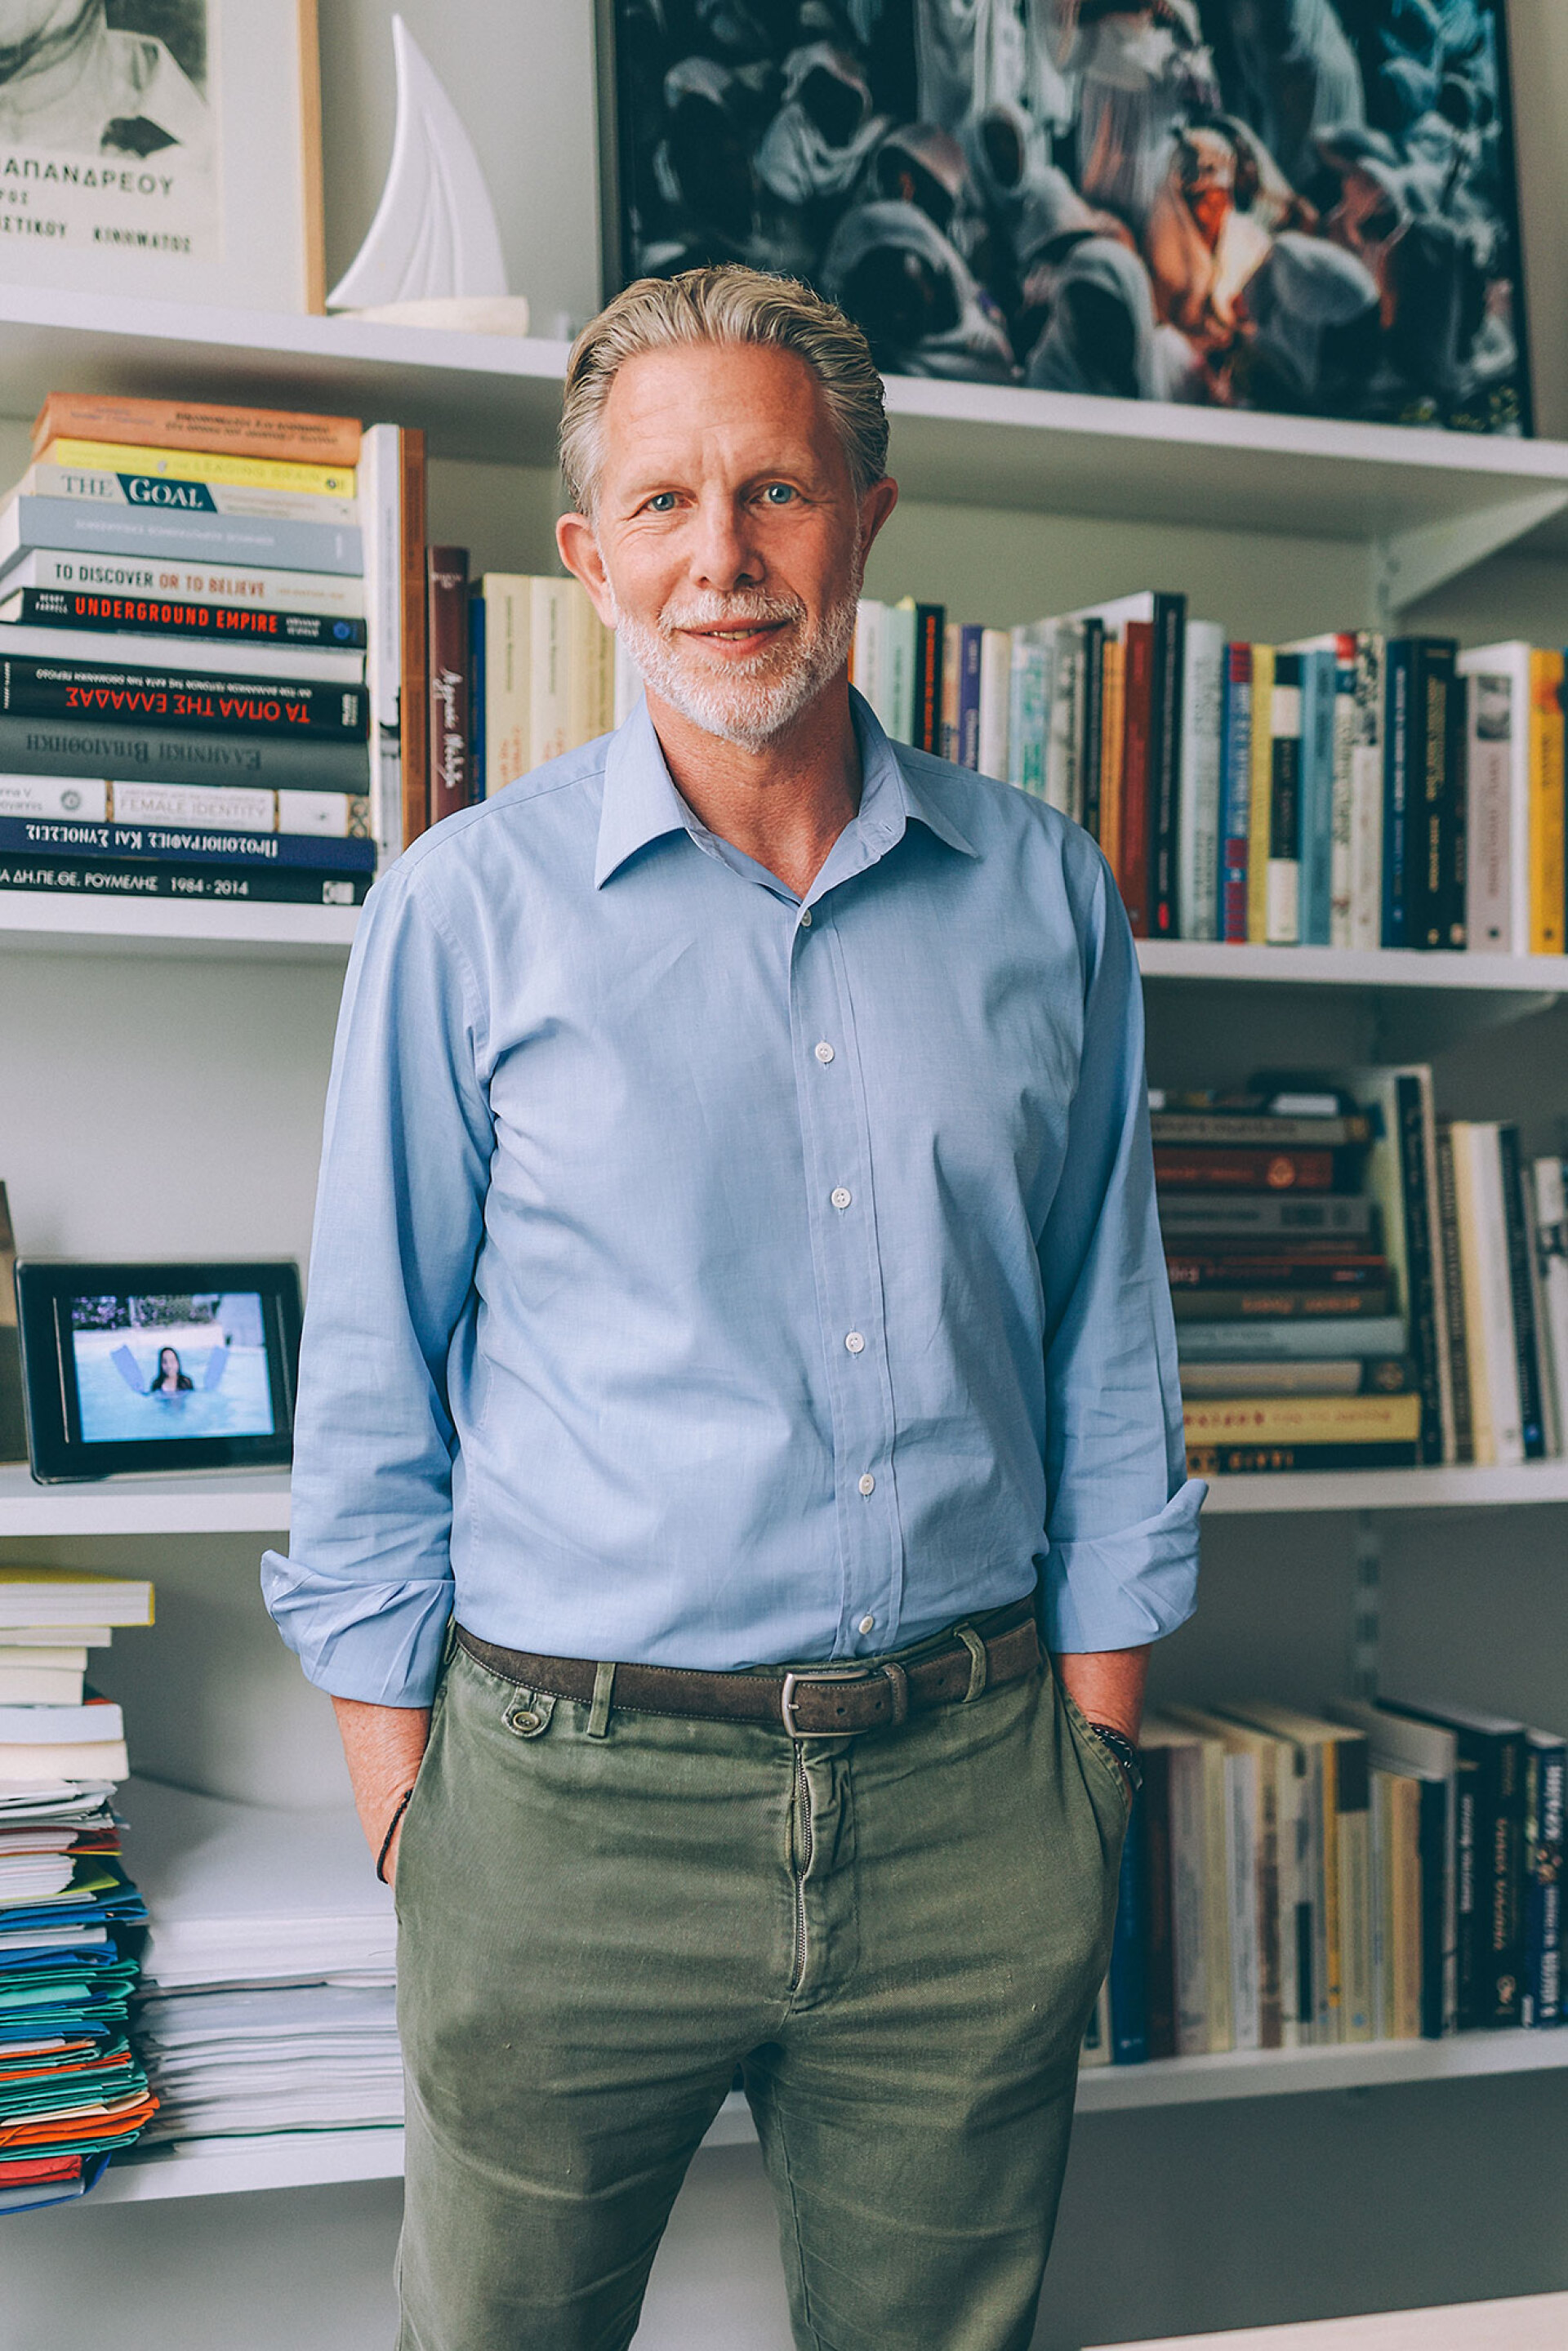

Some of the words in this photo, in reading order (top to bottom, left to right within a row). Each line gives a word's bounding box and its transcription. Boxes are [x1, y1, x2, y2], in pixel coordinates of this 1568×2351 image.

[4, 158, 174, 196] ΑΠΑΝΔΡΕΟΥ
[0, 216, 67, 238] ΣΤΙΚΟΥ
[61, 474, 114, 498] THE
[128, 478, 203, 509] GOAL
[56, 563, 73, 580] TO
[79, 565, 154, 587] DISCOVER
[159, 574, 179, 590] OR
[186, 575, 203, 592] TO
[209, 578, 265, 598] BELIEVE
[75, 596, 210, 627] UNDERGROUND
[216, 611, 278, 634] EMPIRE
[65, 687, 167, 713] ΕΛΛΑΔΑΣ
[173, 693, 214, 717] ΤΗΣ
[219, 697, 280, 722] ΟΠΛΑ
[287, 702, 310, 724] ΤΑ
[120, 799, 185, 816] FEMALE
[192, 803, 266, 819] IDENTITY
[25, 824, 109, 848] ΣΥΝΘΕΣΕΙΣ
[115, 830, 142, 849] ΚΑΙ
[13, 870, 81, 888] ΔΗ.ΠΕ.ΘΕ.
[84, 874, 158, 891] ΡΟΥΜΕΛΗΣ
[171, 878, 204, 893] 1984
[215, 880, 248, 896] 2014
